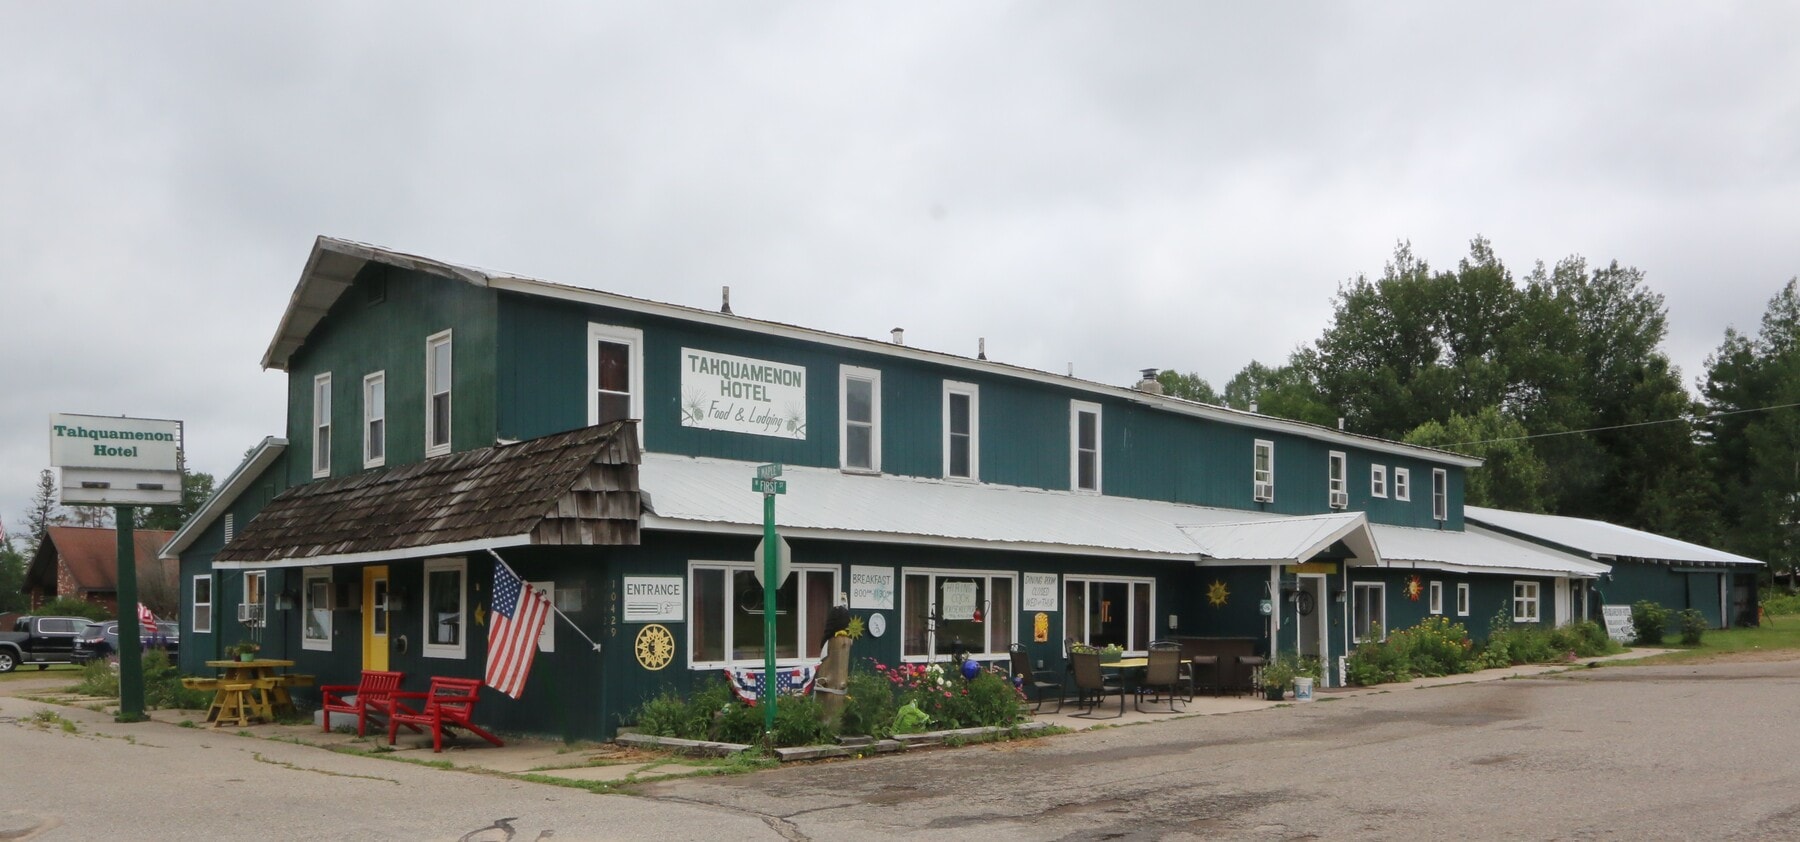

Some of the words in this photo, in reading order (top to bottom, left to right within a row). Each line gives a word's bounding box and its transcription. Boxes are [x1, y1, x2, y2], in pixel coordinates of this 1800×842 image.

[688, 354, 802, 388] TAHQUAMENON
[720, 380, 771, 402] HOTEL
[708, 400, 734, 421] Food
[735, 407, 746, 422] &
[748, 406, 784, 432] Lodging
[53, 425, 175, 442] Tahquamenon
[93, 444, 138, 457] Hotel
[760, 480, 778, 493] FIRST
[852, 573, 892, 586] BREAKFAST
[1025, 575, 1043, 585] DINING
[626, 583, 681, 596] ENTRANCE
[946, 583, 973, 593] HIRING
